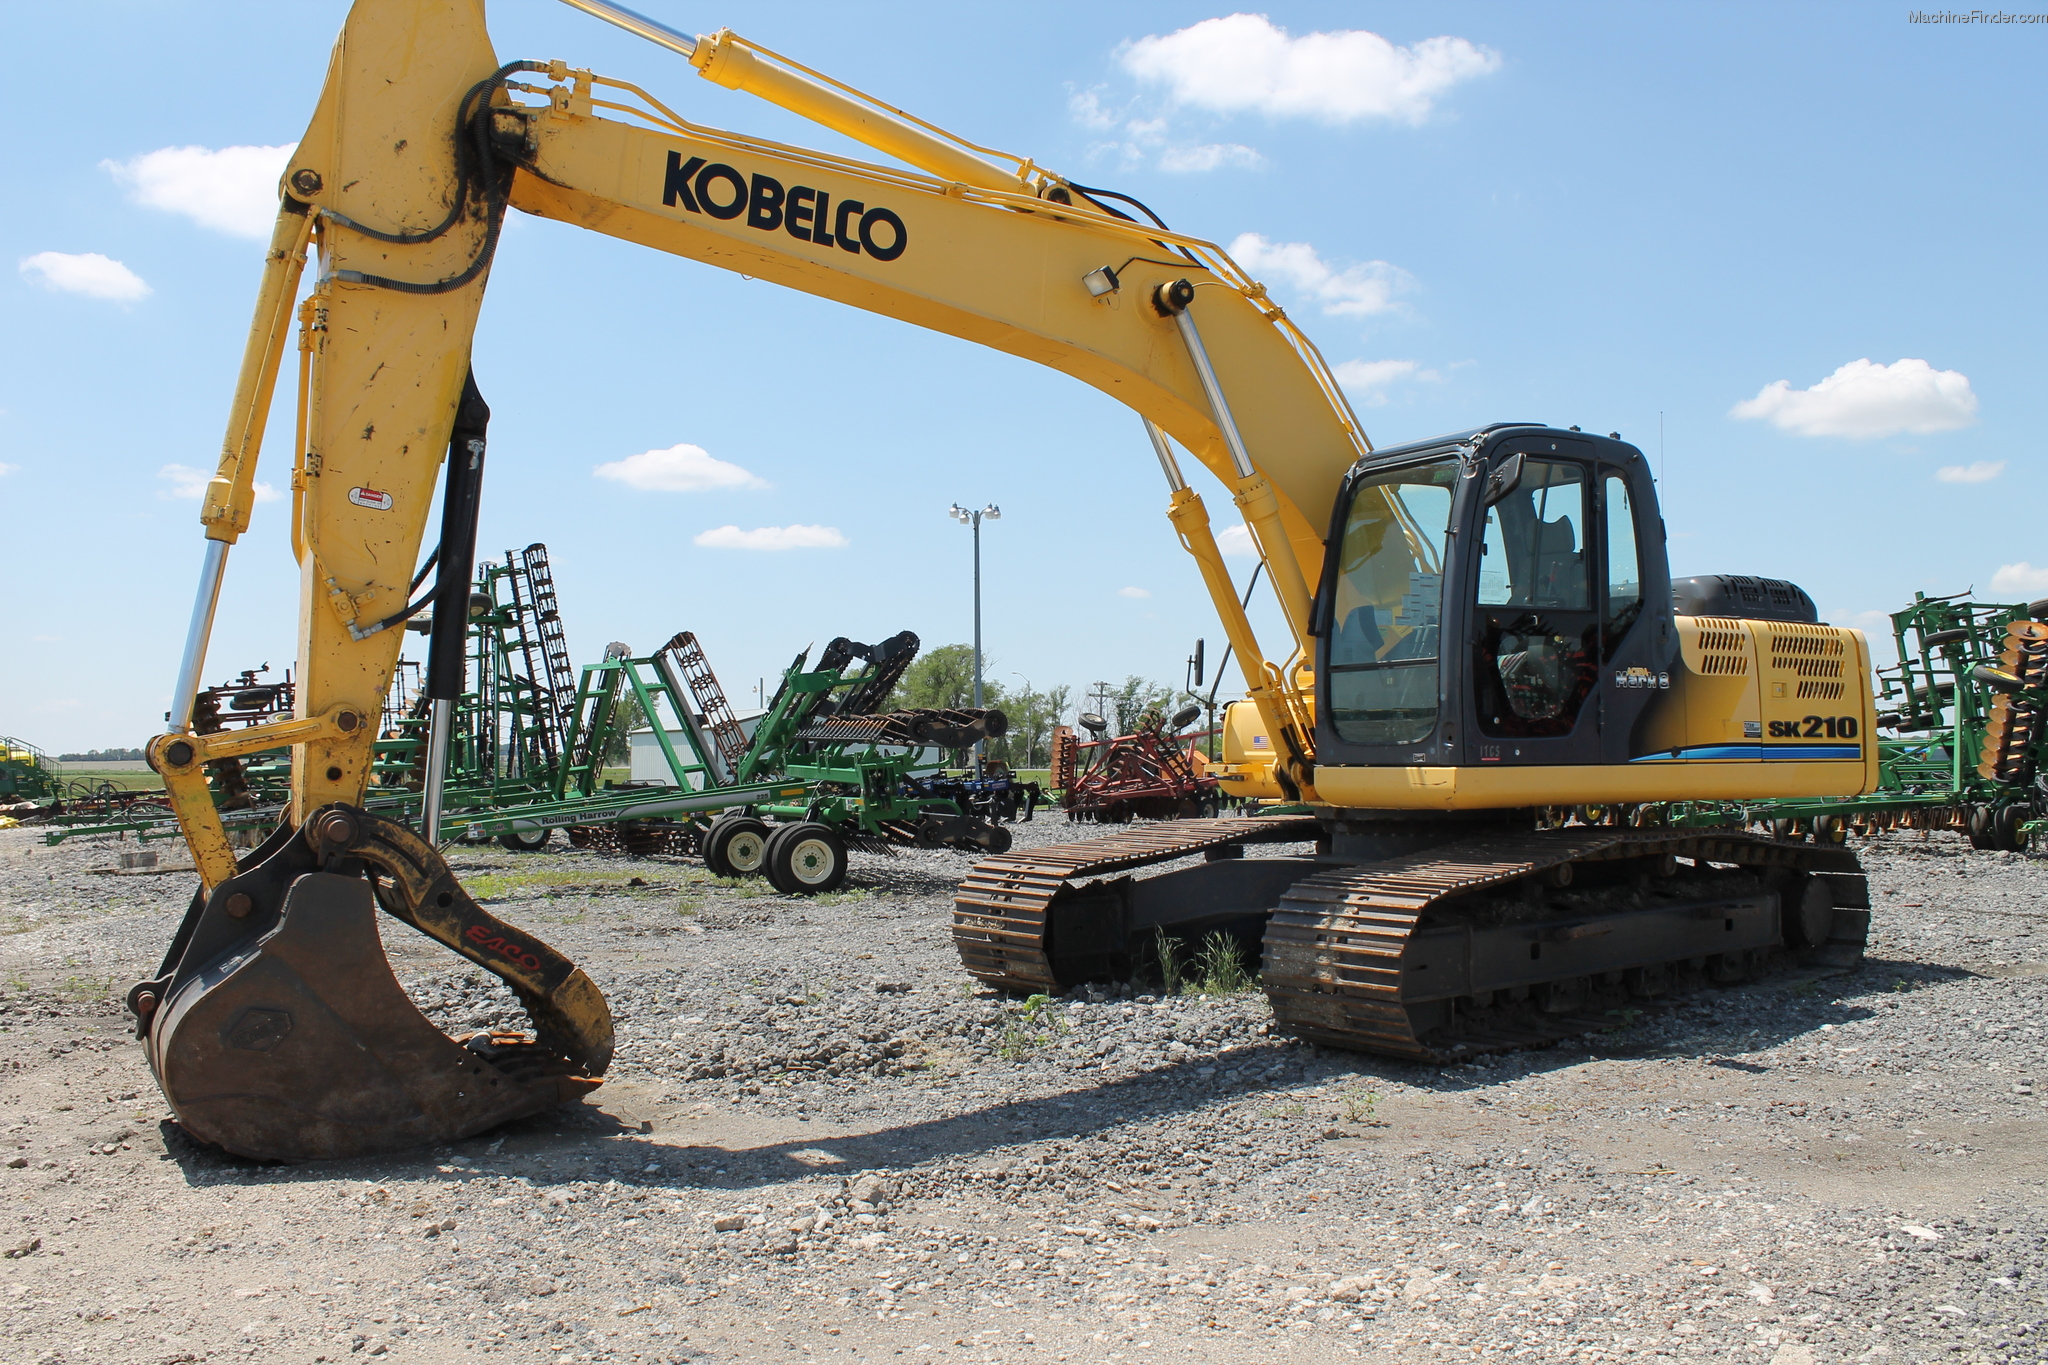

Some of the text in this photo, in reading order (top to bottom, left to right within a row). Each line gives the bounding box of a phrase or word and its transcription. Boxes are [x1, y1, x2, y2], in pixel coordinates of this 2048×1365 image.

[662, 150, 907, 261] KOBELCO
[1658, 671, 1670, 689] 8
[1768, 715, 1858, 738] SK210
[541, 810, 617, 825] Rolling Harrow
